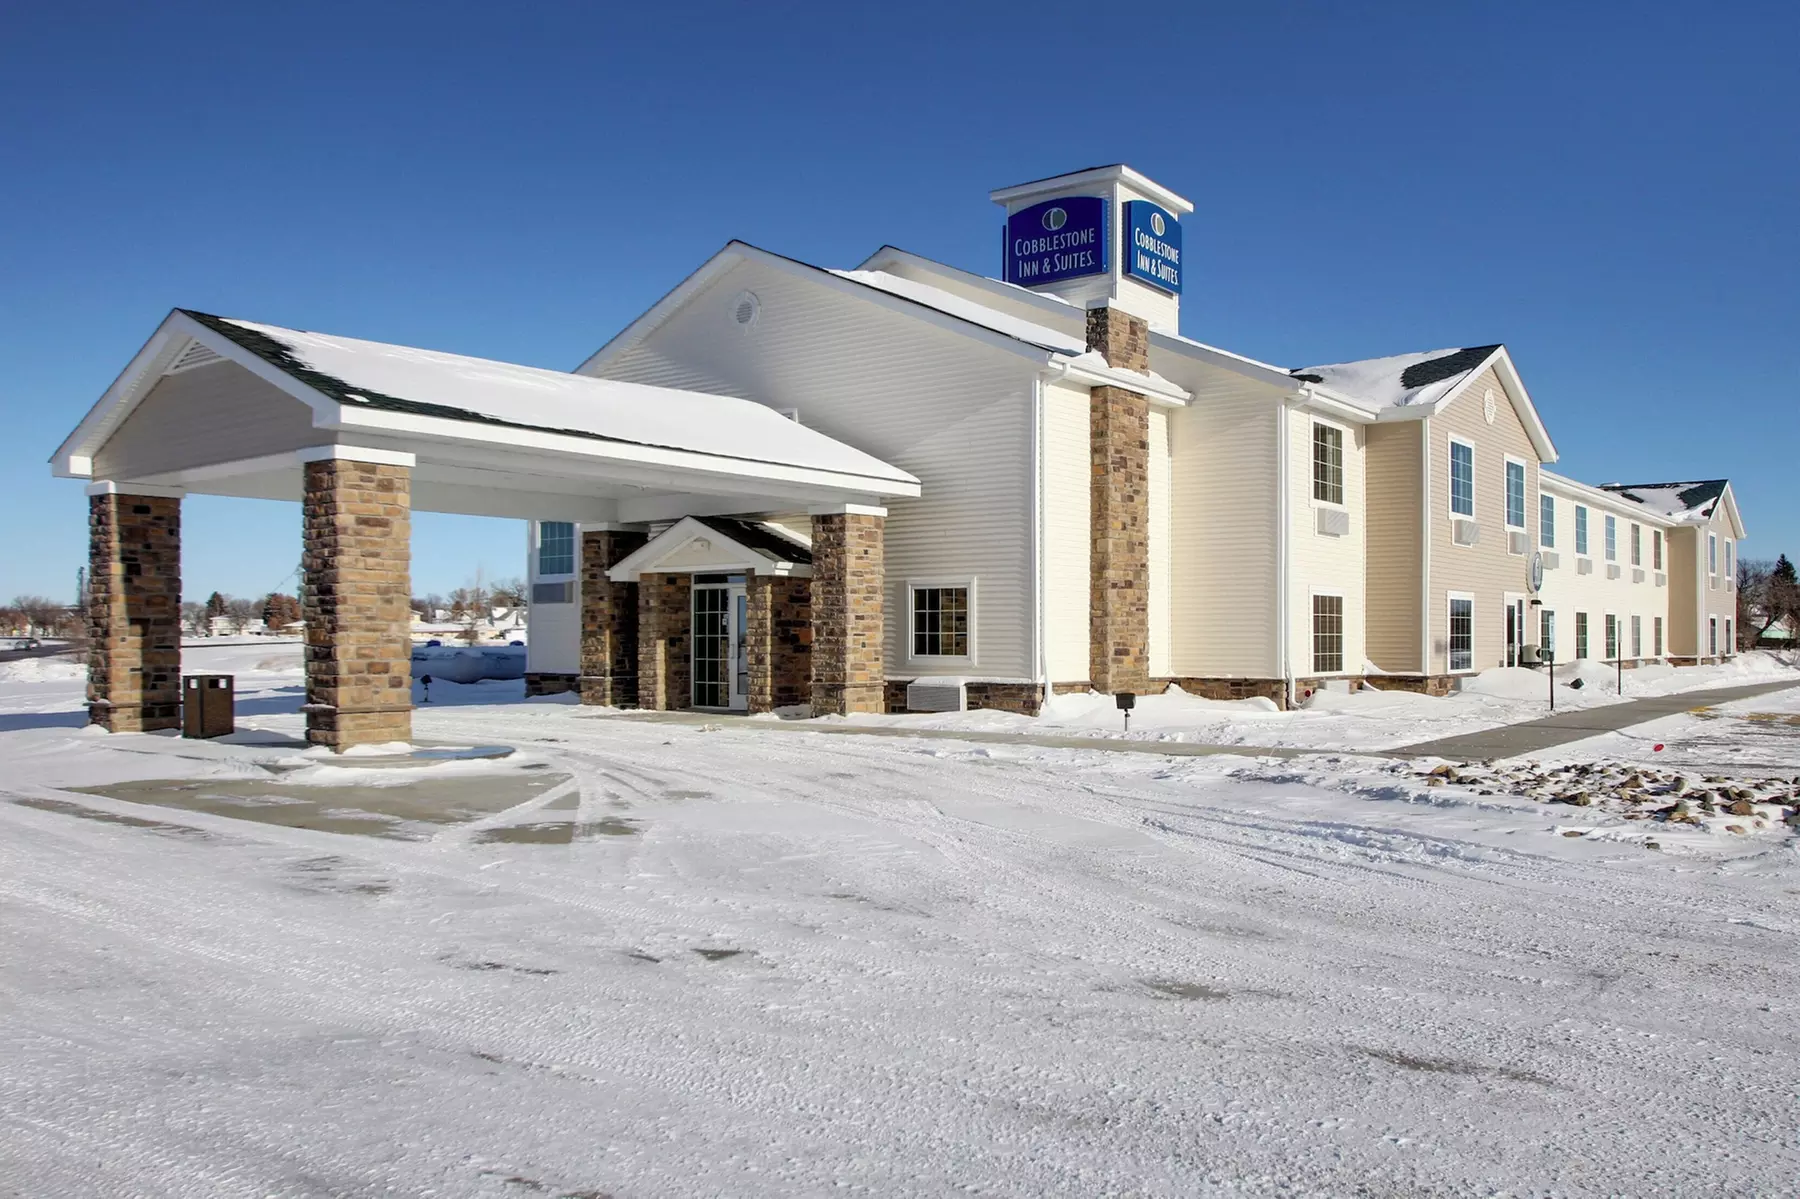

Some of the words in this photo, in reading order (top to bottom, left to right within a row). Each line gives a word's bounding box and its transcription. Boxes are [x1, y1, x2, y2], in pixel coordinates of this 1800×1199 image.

[1015, 228, 1095, 256] COBBLESTONE
[1135, 227, 1179, 264] COBBLESTONE
[1019, 260, 1039, 278] INN
[1042, 257, 1051, 274] &
[1054, 250, 1093, 272] SUITES
[1137, 249, 1150, 273] INN
[1150, 258, 1157, 276] &
[1157, 259, 1179, 285] SUITES
